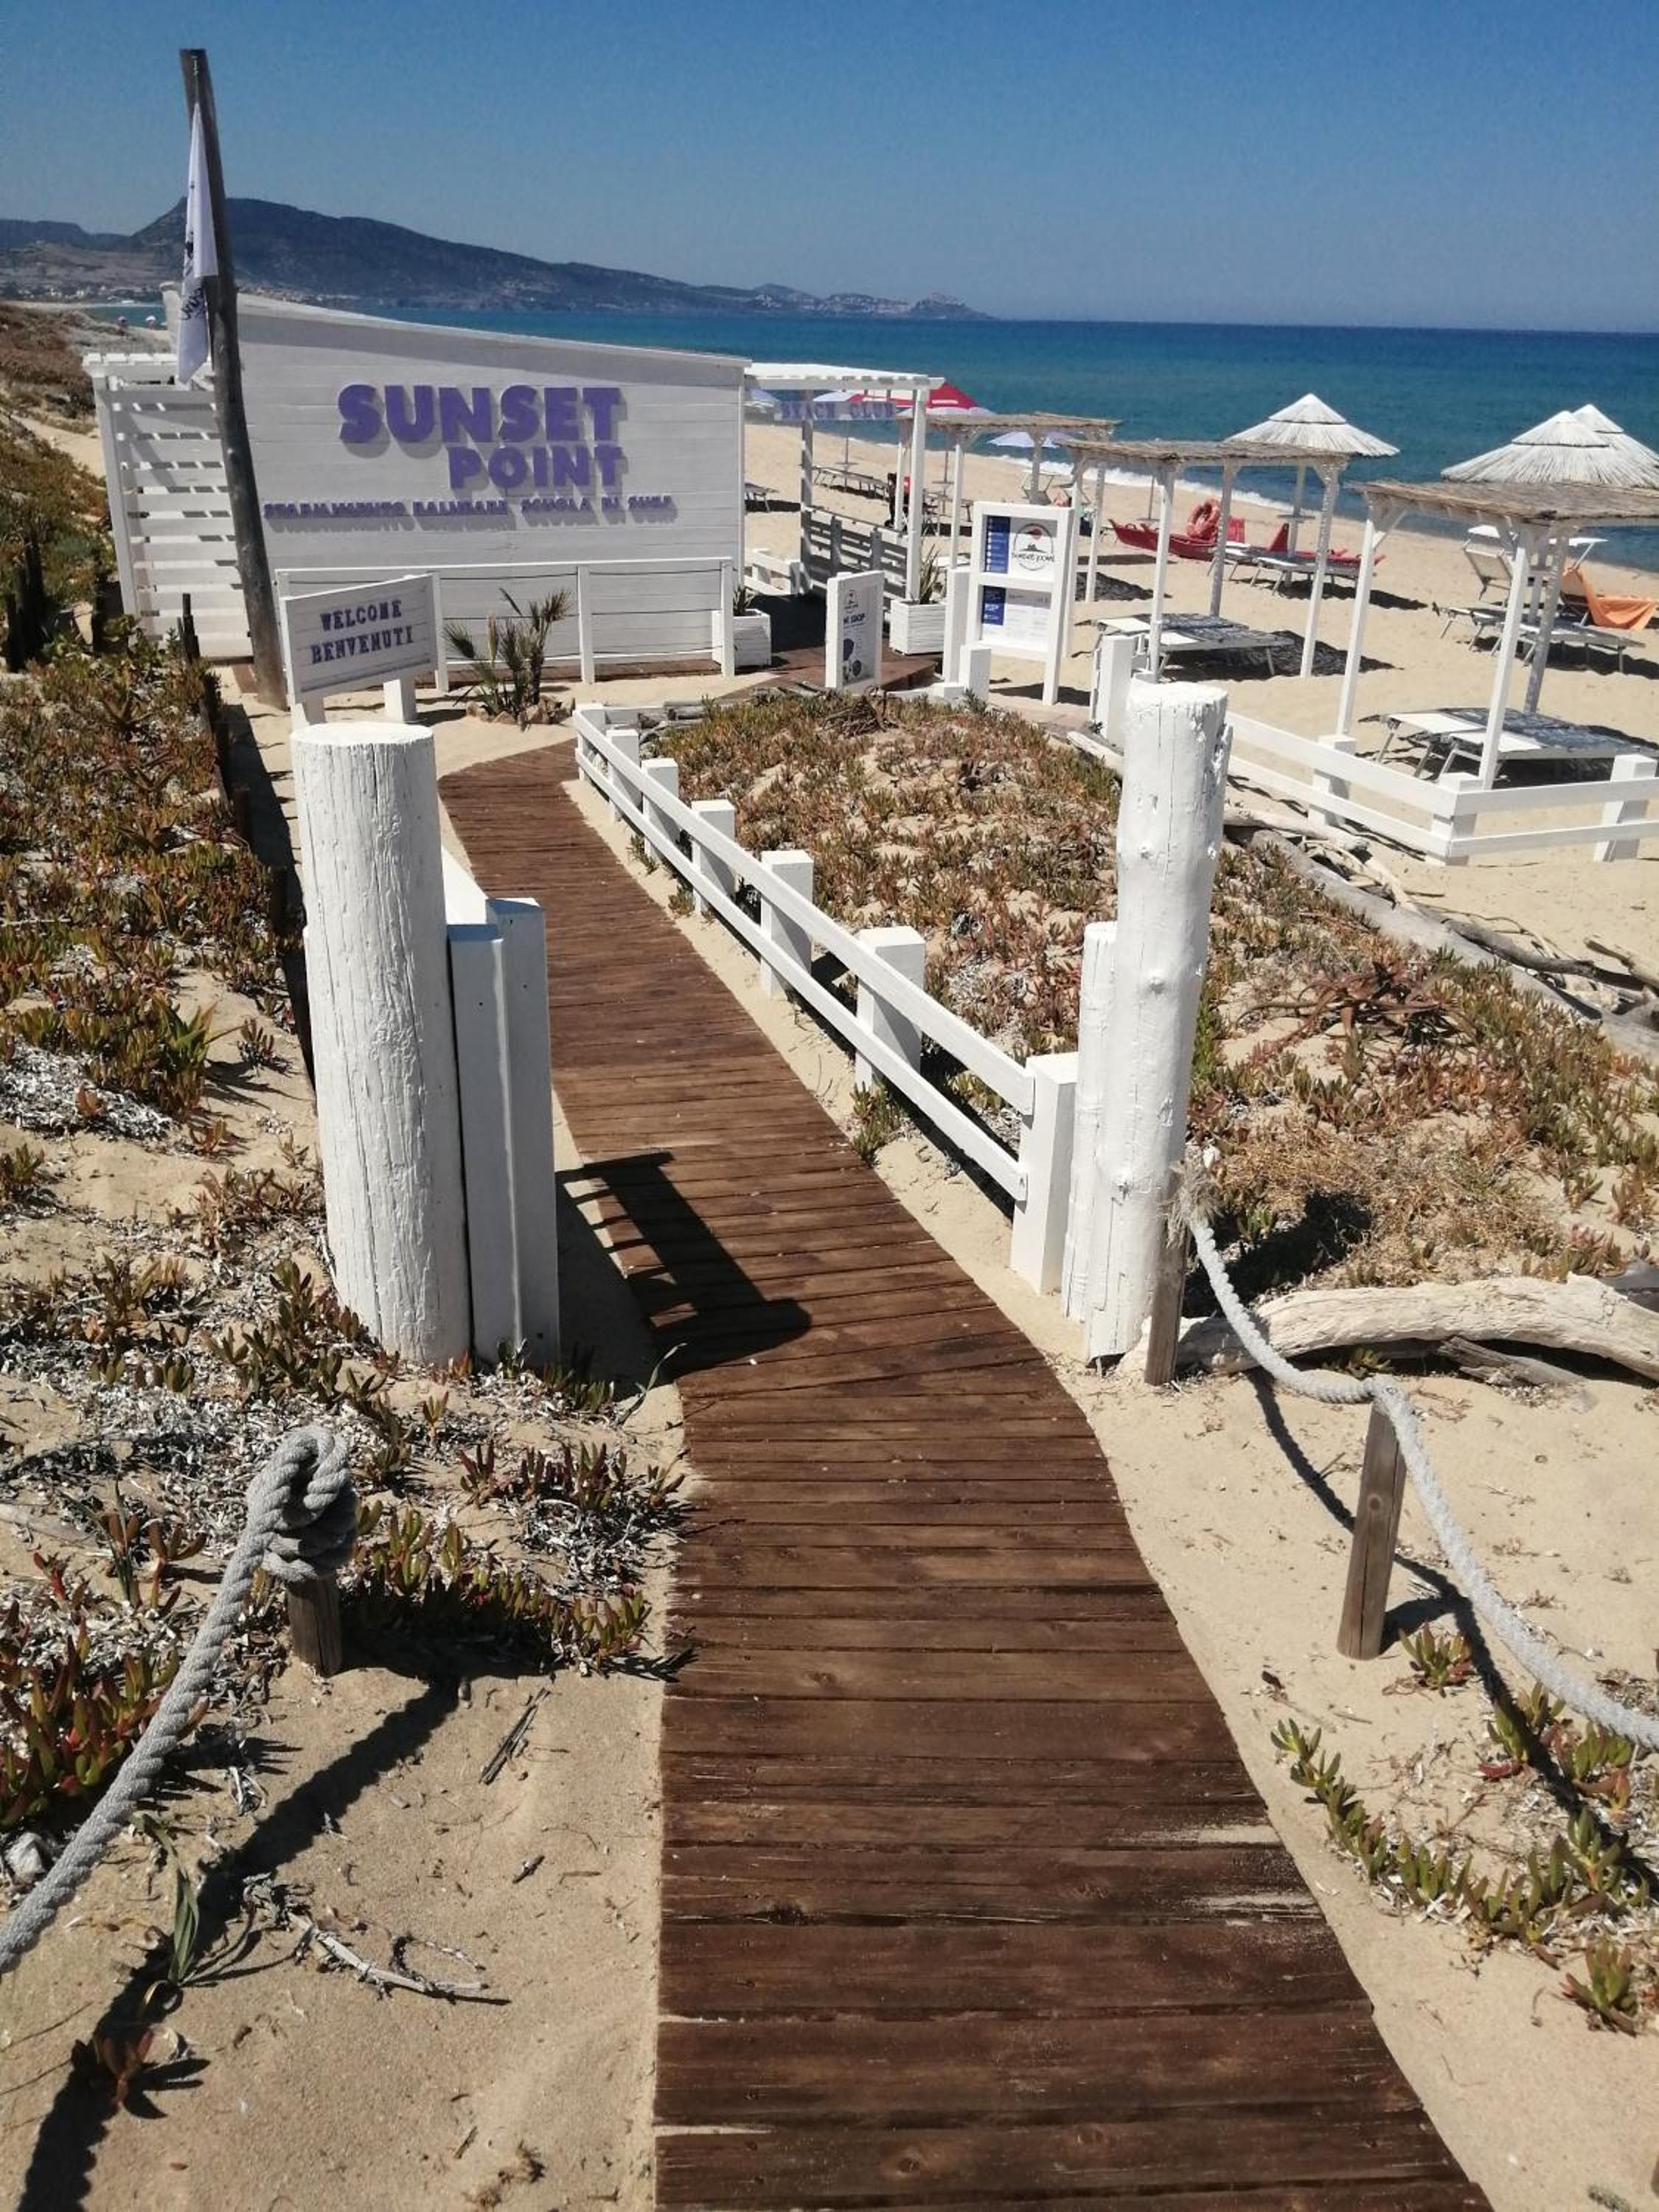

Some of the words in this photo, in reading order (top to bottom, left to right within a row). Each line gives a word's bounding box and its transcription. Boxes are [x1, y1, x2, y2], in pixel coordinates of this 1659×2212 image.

[338, 383, 622, 443] SUNSET
[782, 402, 835, 420] BEACH
[849, 402, 894, 420] CLUB
[448, 445, 624, 489] POINT
[320, 599, 402, 631] WELCOME
[310, 625, 414, 664] BENVENUTI
